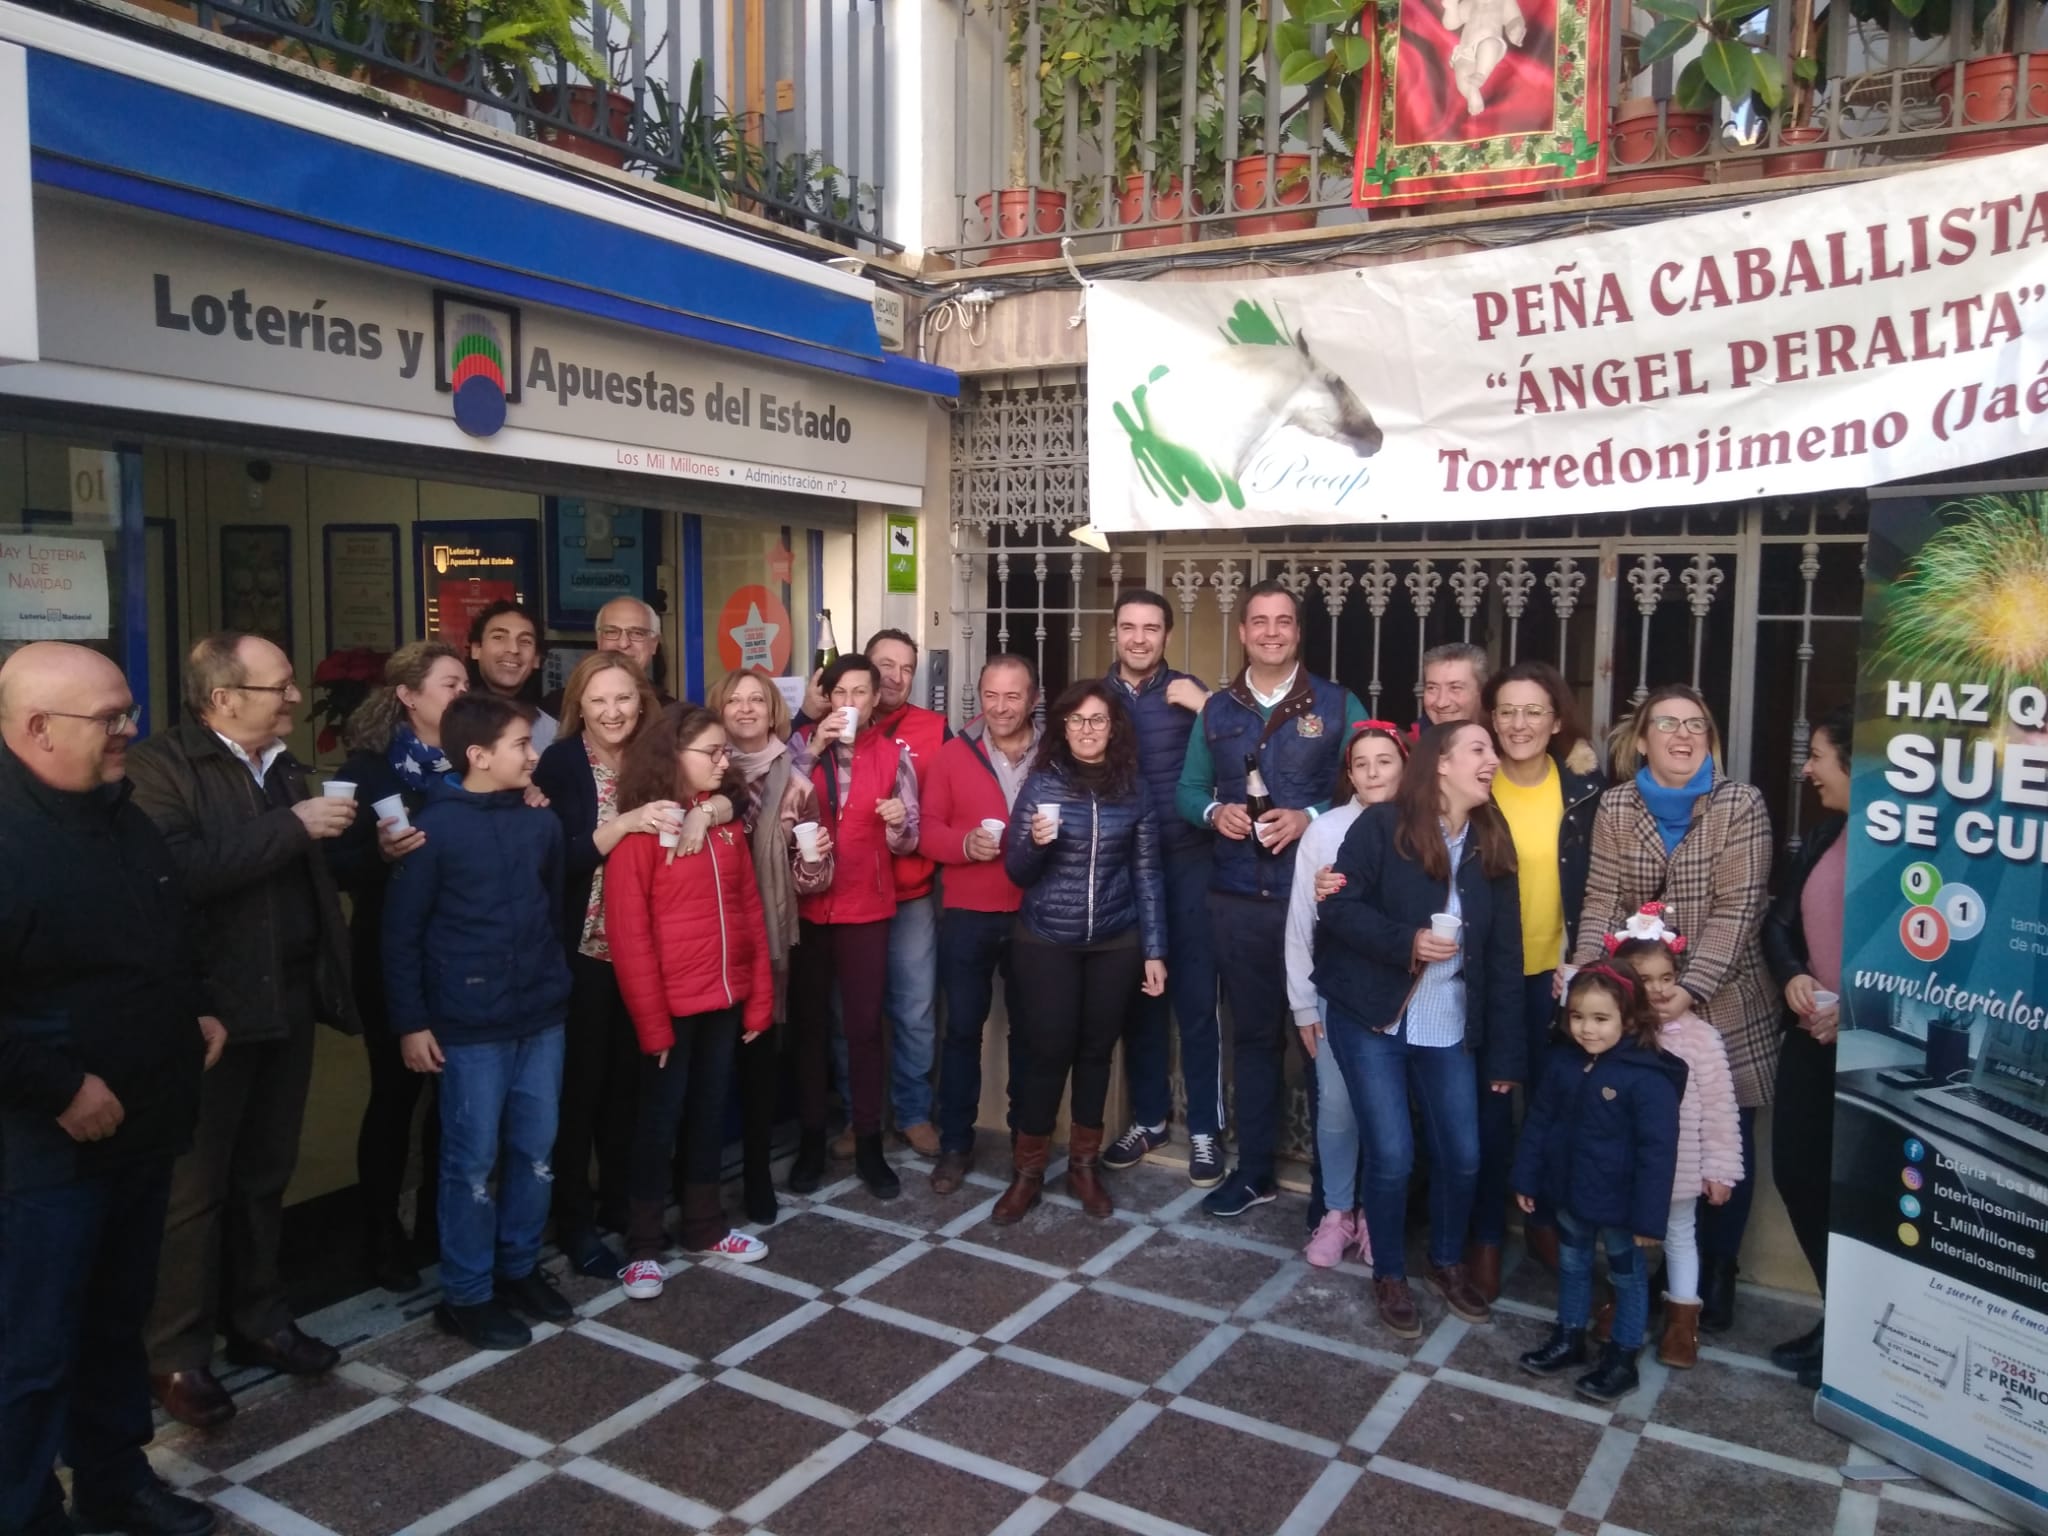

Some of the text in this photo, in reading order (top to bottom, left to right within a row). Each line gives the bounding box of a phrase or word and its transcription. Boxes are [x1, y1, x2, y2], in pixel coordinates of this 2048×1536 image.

[1473, 190, 2048, 341] PEÑA CABALLISTA
[154, 273, 424, 379] Loterías y
[526, 346, 851, 444] Apuestas del Estado
[617, 448, 639, 466] Los
[646, 453, 665, 469] Mil
[670, 456, 720, 477] Millones
[745, 467, 823, 491] Administración
[841, 480, 848, 494] 2
[1438, 410, 1909, 493] Torredonjimeno
[8, 572, 73, 590] NAVIDAD
[31, 562, 50, 575] DE
[1885, 680, 2048, 729] HAZ Q
[1884, 733, 2048, 807] SUE
[1865, 800, 2048, 864] SE CU
[1912, 872, 1922, 888] 0
[1916, 919, 1926, 939] 1
[1959, 901, 1969, 921] 1
[2009, 937, 2028, 951] de
[1933, 1211, 2036, 1259] L_MilMillones
[1929, 1277, 1943, 1290] La
[1946, 1286, 1983, 1308] suerte
[1987, 1302, 2008, 1315] que
[1989, 1369, 2048, 1406] PREMIO
[1992, 1356, 2037, 1385] 92845
